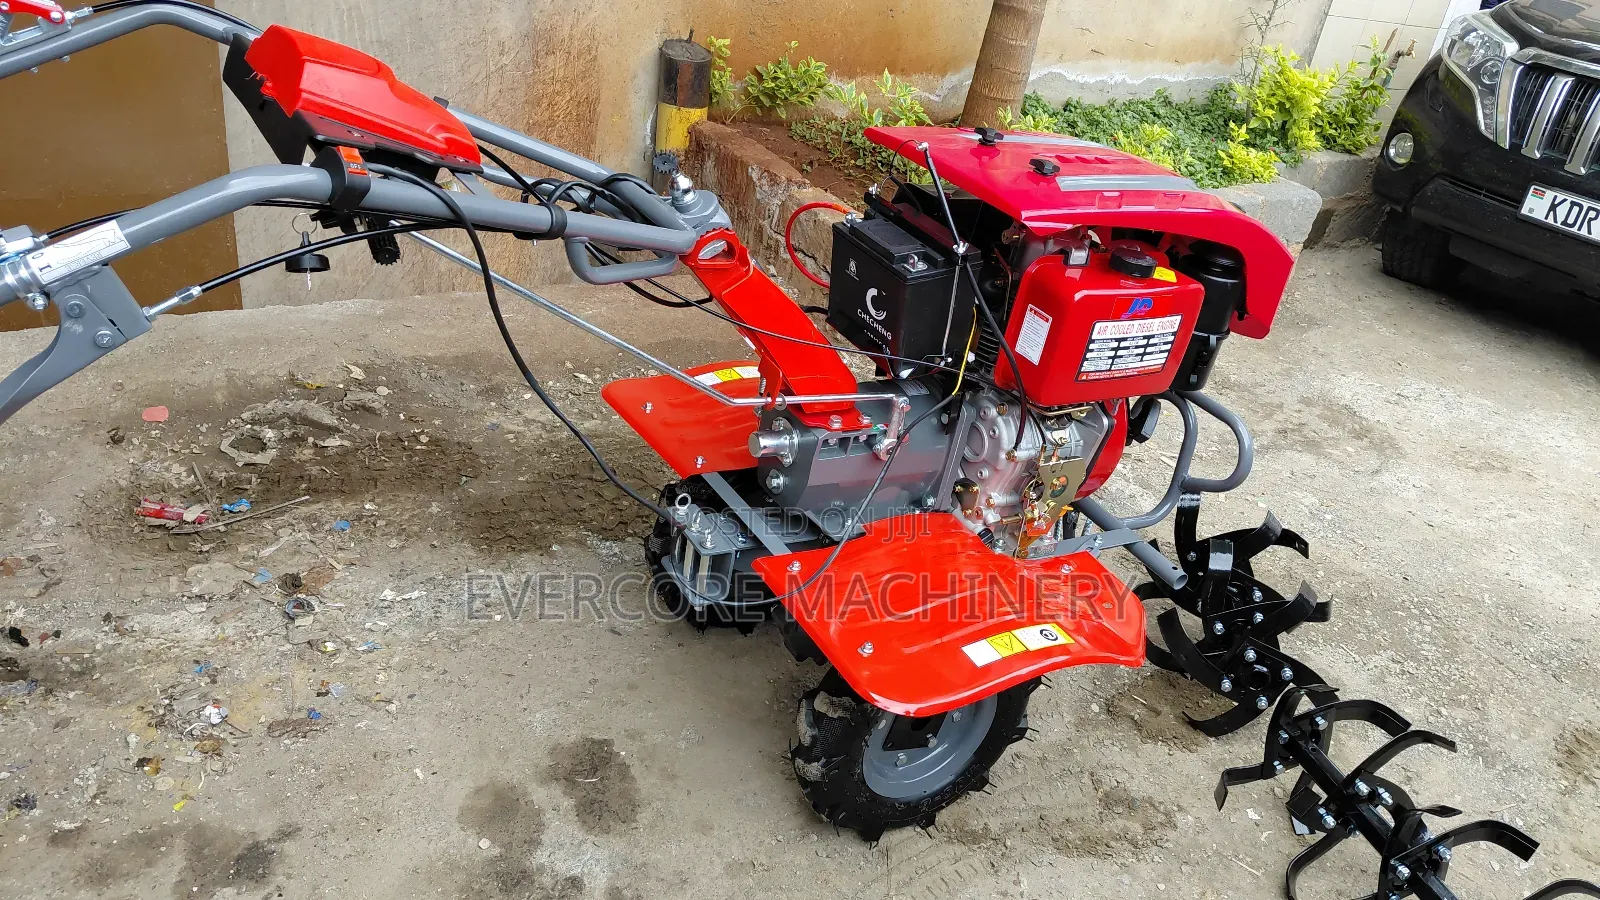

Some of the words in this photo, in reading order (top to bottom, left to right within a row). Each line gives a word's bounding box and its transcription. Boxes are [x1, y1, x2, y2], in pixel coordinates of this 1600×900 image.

[1544, 195, 1600, 235] KDR
[857, 309, 892, 340] CHECHENG
[1097, 325, 1109, 336] AIR
[1110, 323, 1135, 336] COOLED
[1136, 321, 1155, 334] DIESEL
[1156, 318, 1178, 331] ENGINE
